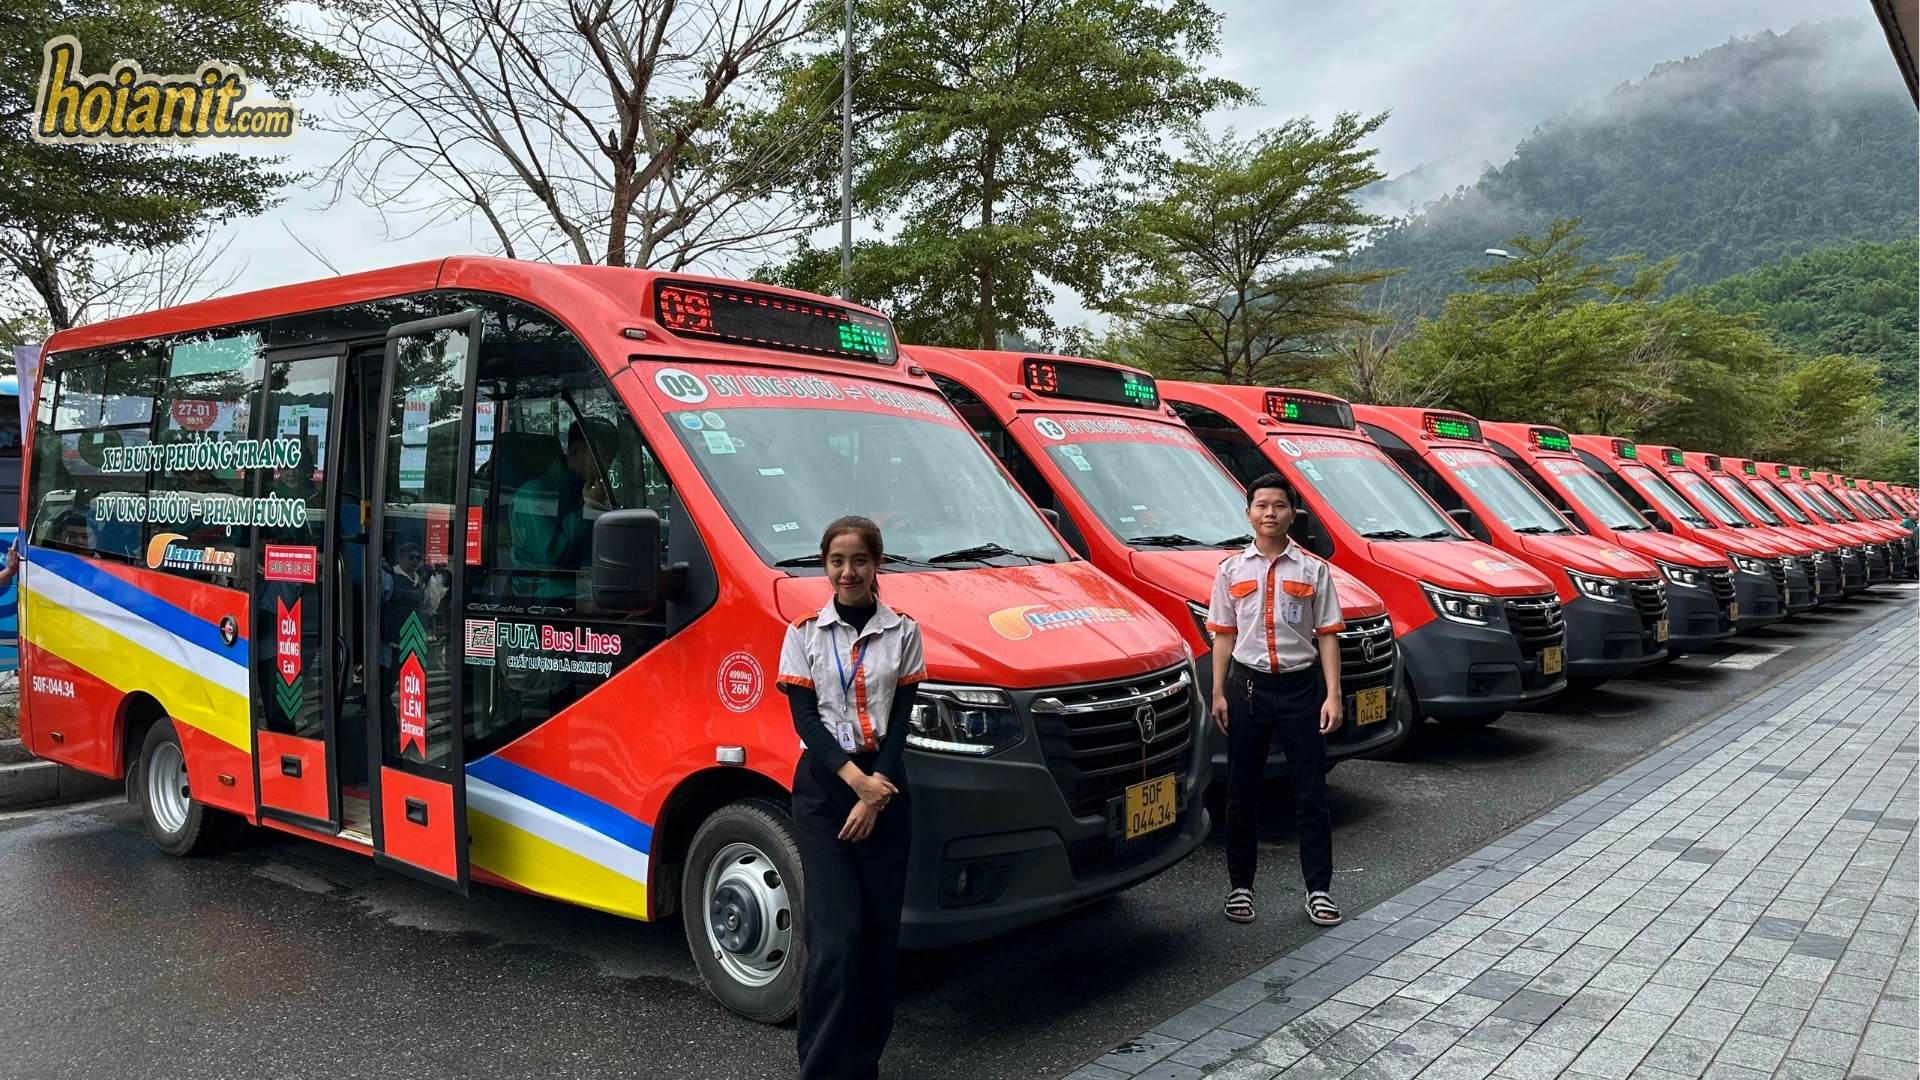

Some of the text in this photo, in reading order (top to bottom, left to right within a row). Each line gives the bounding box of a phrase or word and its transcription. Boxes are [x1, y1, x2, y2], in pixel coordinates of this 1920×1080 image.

[661, 290, 709, 330] 09
[660, 374, 704, 397] 09
[705, 375, 743, 397] BV
[736, 375, 793, 397] UNG
[1029, 364, 1055, 391] 13
[178, 404, 211, 416] 27-01
[1037, 420, 1064, 436] 13
[101, 437, 301, 473] XE BUÝT PHƯƠNG TRANG
[95, 496, 117, 521] BV
[117, 496, 147, 522] UNG
[147, 491, 190, 524] BƯỚU
[203, 497, 251, 537] PHẠM
[281, 615, 297, 636] CỬA
[280, 637, 299, 656] XUỐNG
[496, 622, 622, 655] FUTA Bus Lines
[283, 660, 295, 674] Exit
[506, 653, 529, 669] CHẤT
[529, 656, 559, 672] LƯỢNG
[559, 658, 571, 671] LÀ
[571, 660, 597, 674] DANH
[33, 676, 75, 698] 50F-044.34
[404, 671, 421, 696] CỬA
[731, 683, 750, 695] 26N
[403, 695, 422, 719] LÊN
[401, 718, 424, 737] Entrance
[1142, 781, 1163, 806] 50F
[1132, 802, 1172, 834] 044.34
